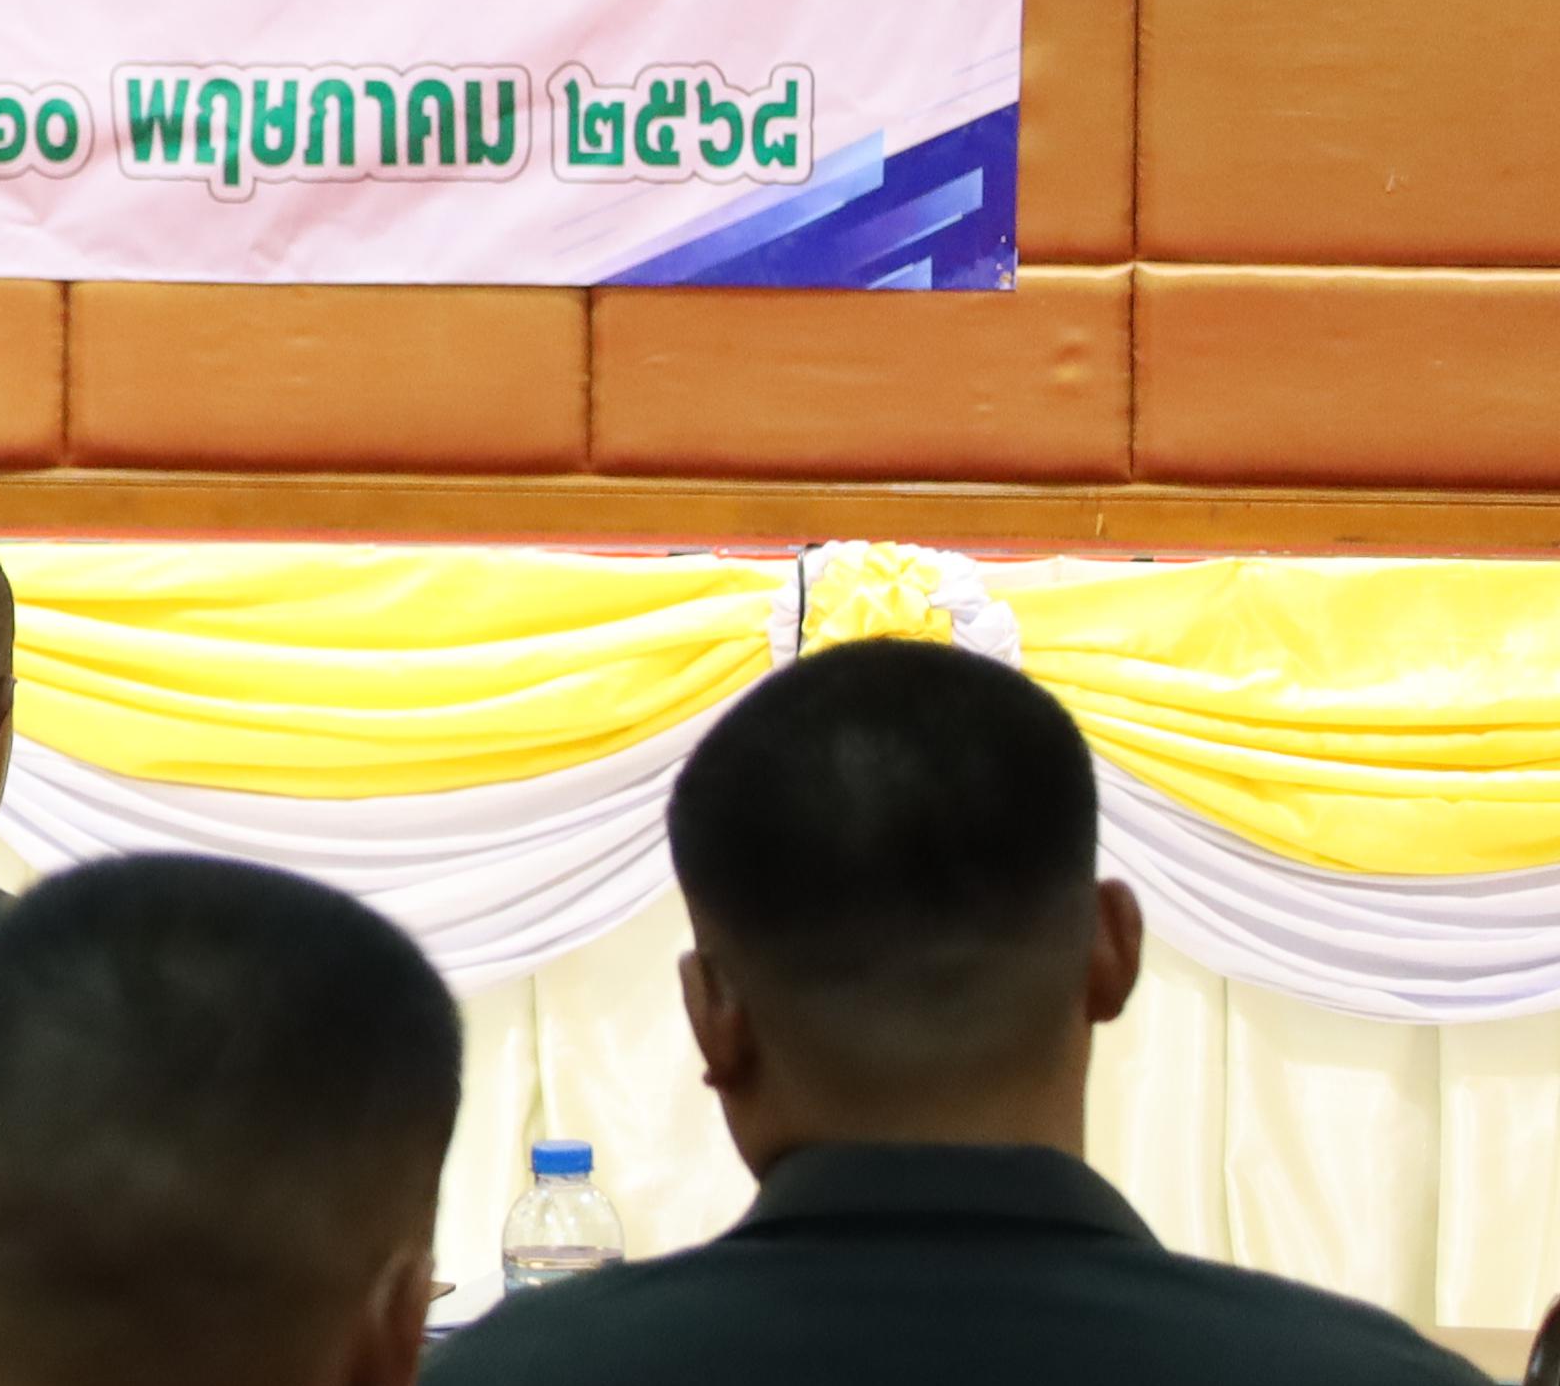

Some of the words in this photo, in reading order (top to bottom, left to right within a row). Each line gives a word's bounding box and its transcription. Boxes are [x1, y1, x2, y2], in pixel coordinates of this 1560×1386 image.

[126, 76, 517, 187] พฤษภาคม
[565, 77, 800, 170] ๒๕๖๘
